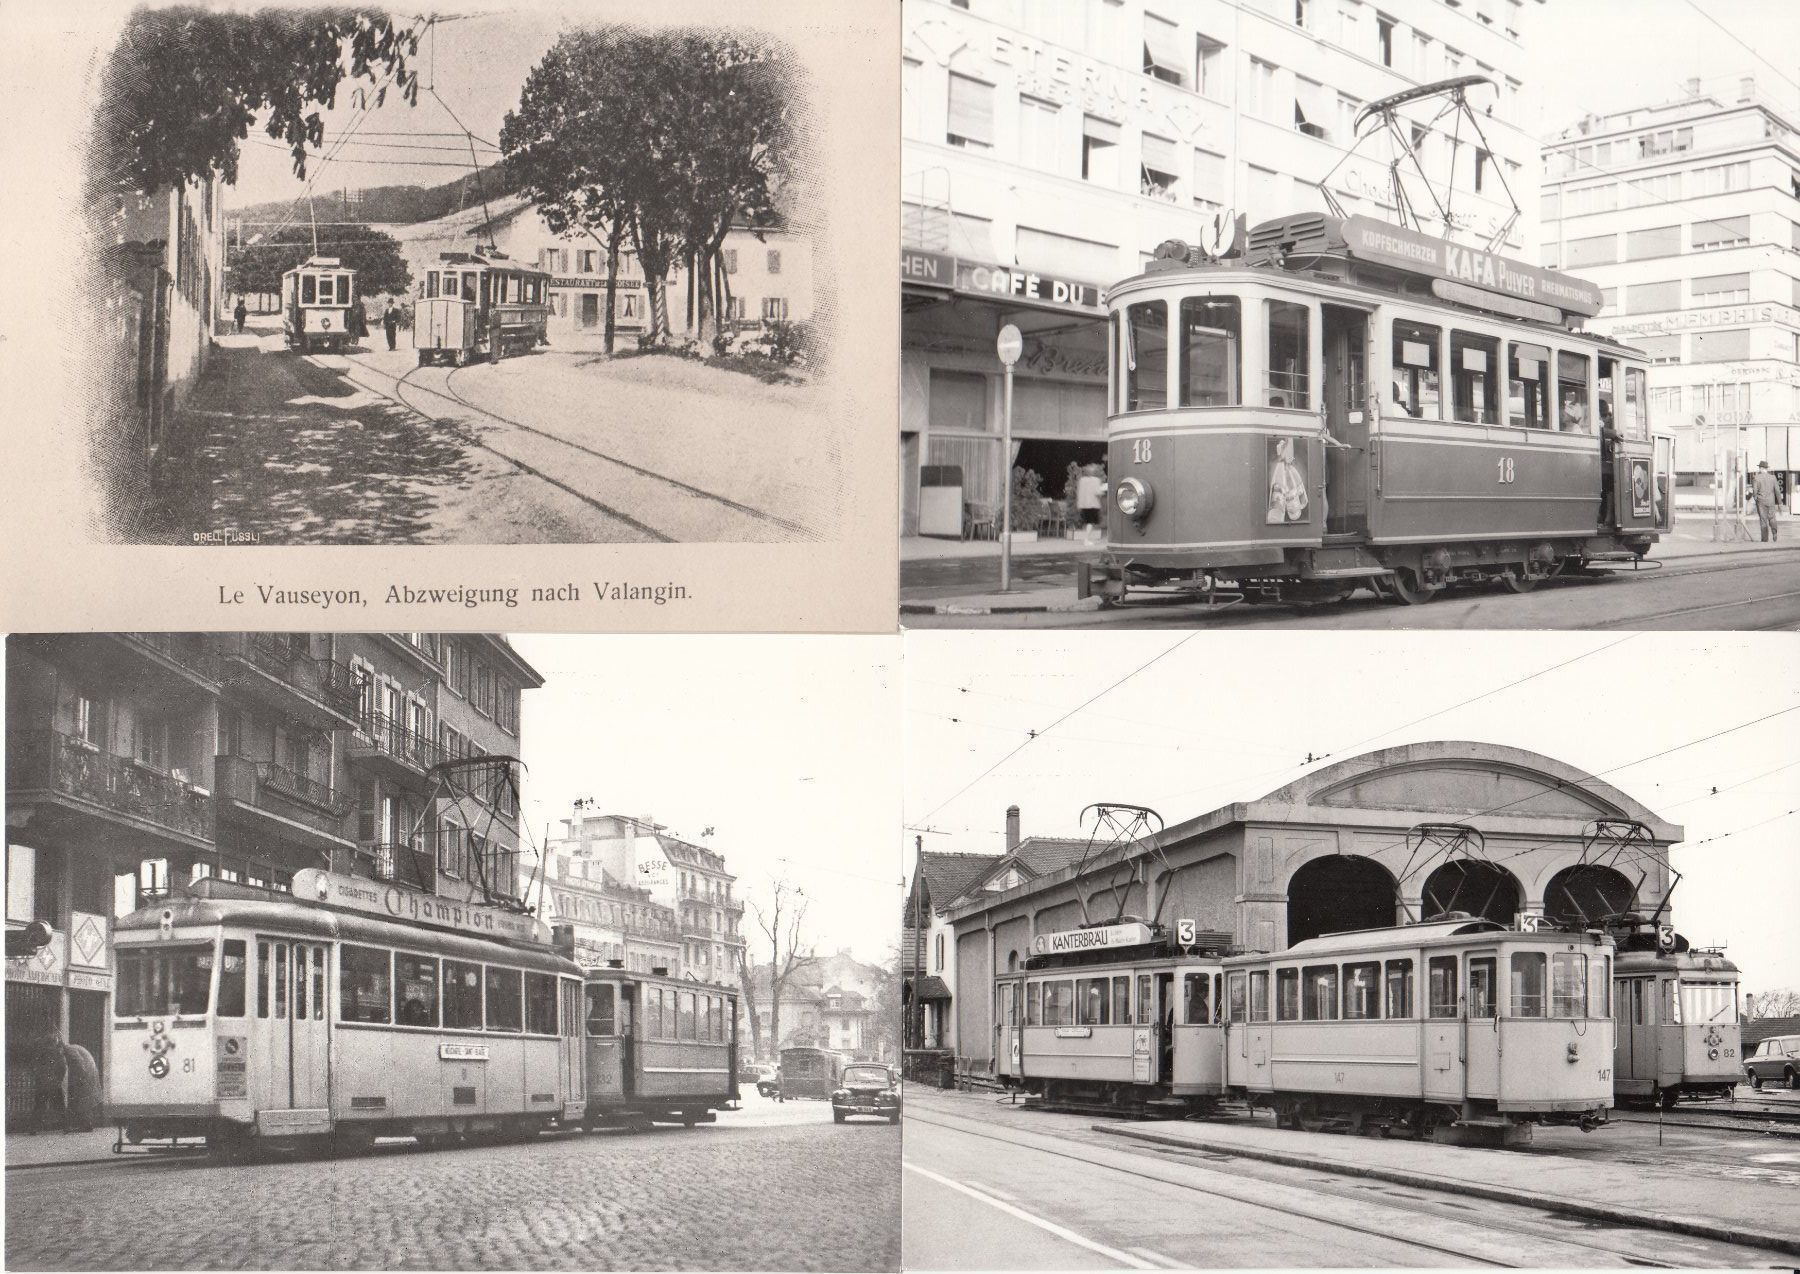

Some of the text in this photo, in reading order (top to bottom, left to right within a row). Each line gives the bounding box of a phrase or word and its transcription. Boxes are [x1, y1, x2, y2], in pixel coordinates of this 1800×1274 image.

[1213, 213, 1220, 250] 1
[1361, 230, 1437, 264] KOPFSCHMERZEN
[1444, 245, 1496, 287] KAFA
[1541, 279, 1592, 305] RHEUMATISMUS
[548, 278, 595, 287] ESTAURANT
[972, 266, 1040, 299] CAFÉ
[1052, 280, 1084, 306] DU
[1666, 306, 1774, 330] MEMPHIS
[1132, 438, 1152, 465] 18
[1497, 457, 1515, 484] 18
[149, 863, 158, 893] 1
[637, 860, 668, 873] BESSE
[384, 887, 494, 931] Champion
[1180, 921, 1194, 942] 3
[1523, 916, 1536, 932] 3
[1051, 928, 1109, 951] KANTERBRÄU
[1662, 927, 1674, 946] 3
[1723, 1048, 1735, 1058] 82
[182, 1057, 195, 1073] 81
[1597, 1068, 1611, 1082] 147
